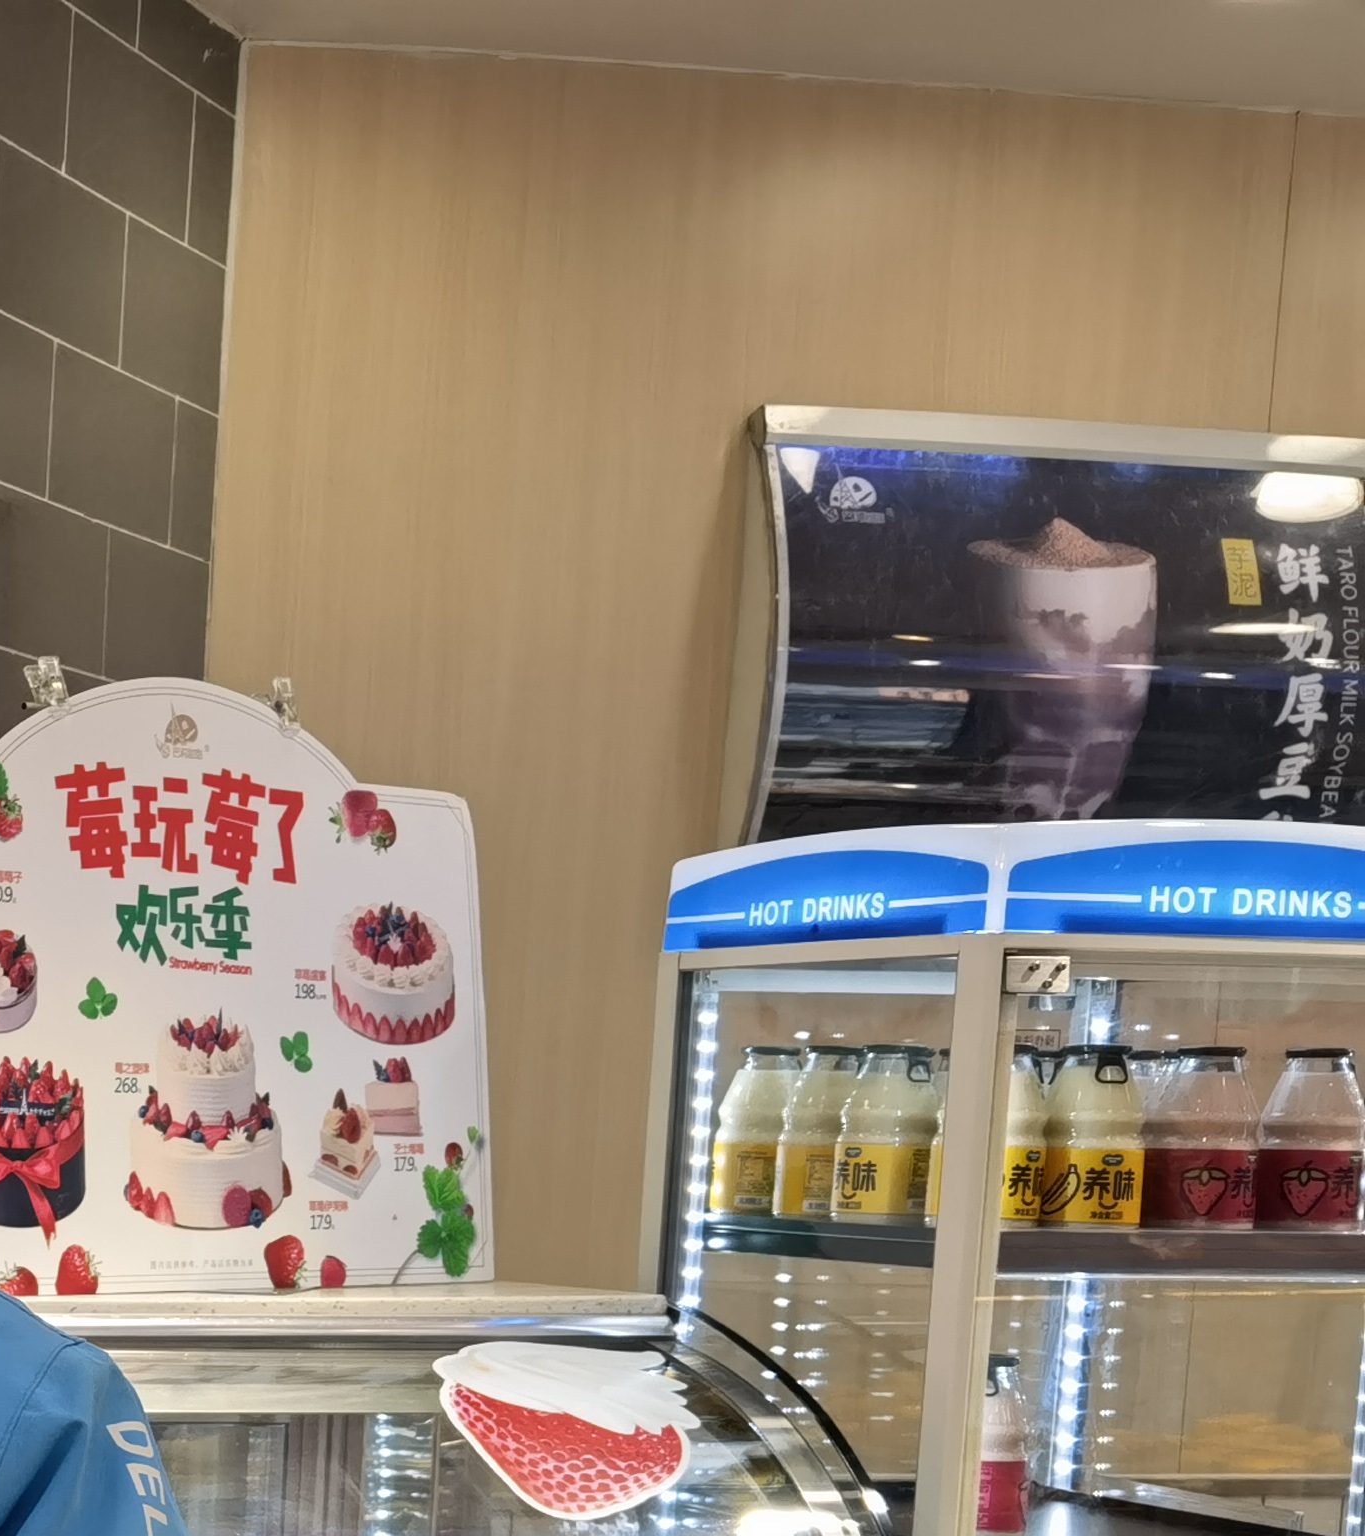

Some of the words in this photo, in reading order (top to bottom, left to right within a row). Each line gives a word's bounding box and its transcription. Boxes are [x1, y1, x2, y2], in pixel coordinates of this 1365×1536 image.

[1226, 546, 1258, 599] 芋泥
[1336, 545, 1358, 602] TARO
[1342, 605, 1360, 674] FLOUR
[1259, 543, 1334, 819] 鲜奶厚豆
[1338, 679, 1359, 727] MILK
[1319, 731, 1354, 818] SOYBEA
[55, 760, 305, 885] 莓玩莓了
[749, 900, 793, 926] HOT
[802, 892, 886, 923] DRINKS
[1149, 886, 1218, 914] HOT
[1231, 886, 1353, 918] DRINKS
[115, 884, 253, 965] 欢乐季
[168, 956, 219, 975] Strawberry
[218, 961, 253, 976] Season
[294, 983, 316, 999] 198
[114, 1077, 139, 1093] 268
[394, 1156, 416, 1172] 17.9
[1082, 1167, 1135, 1201] 养味
[310, 1214, 333, 1230] 17.9
